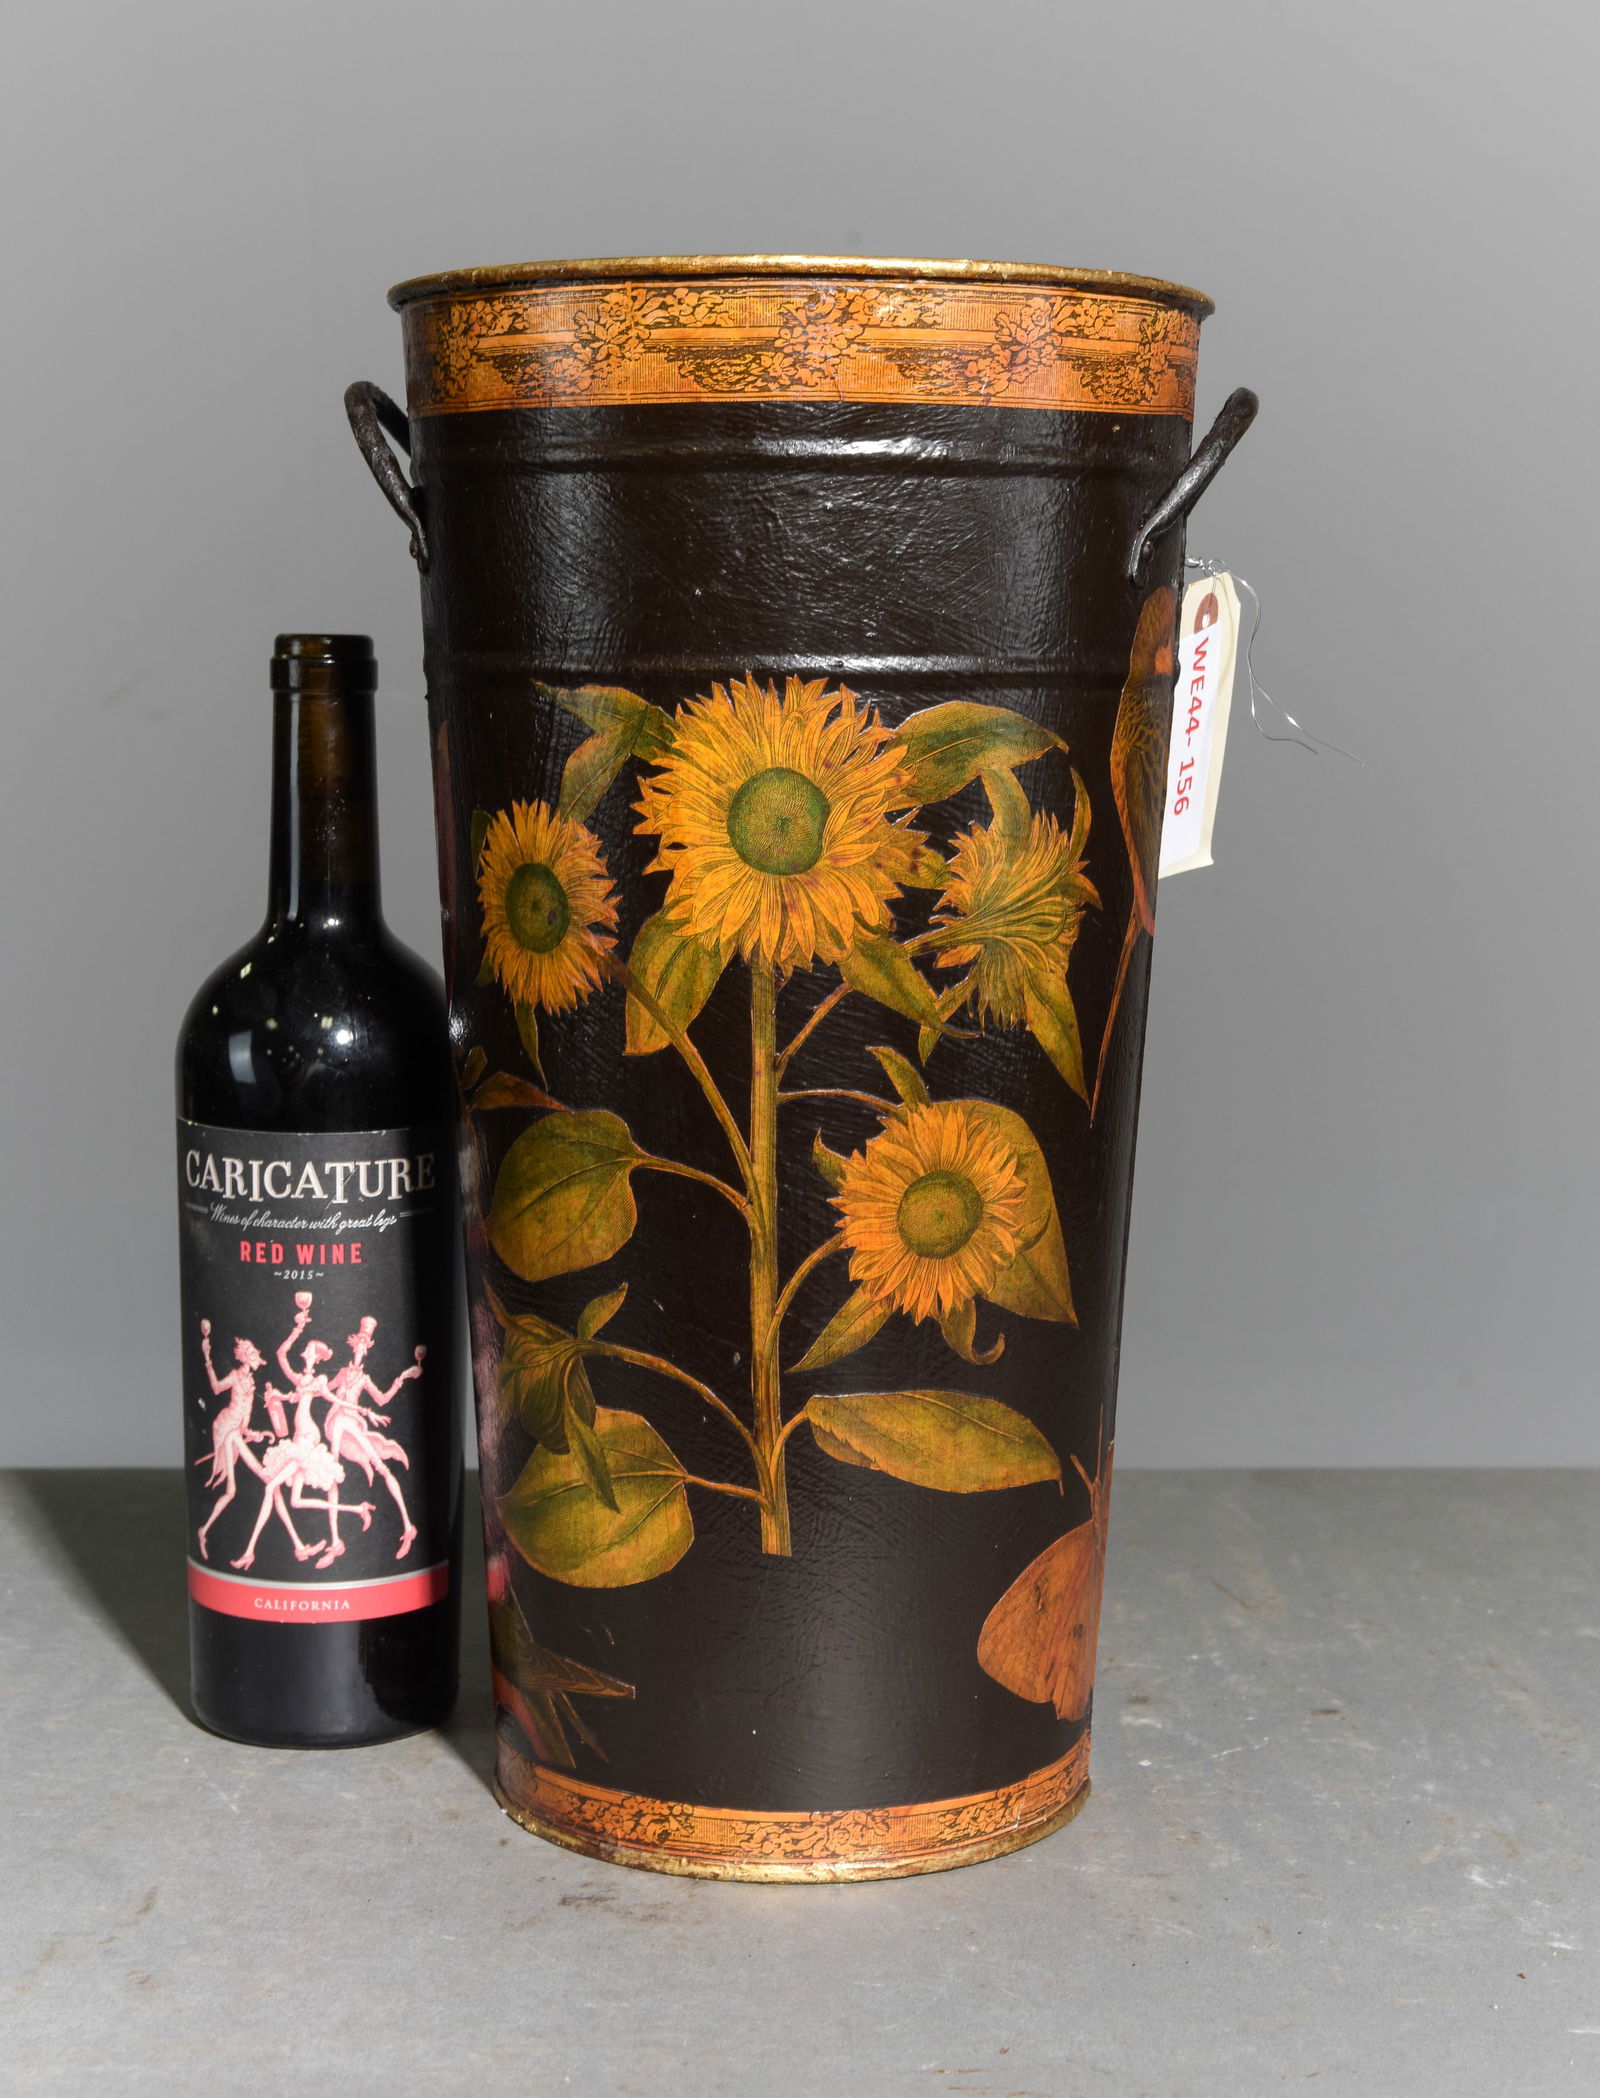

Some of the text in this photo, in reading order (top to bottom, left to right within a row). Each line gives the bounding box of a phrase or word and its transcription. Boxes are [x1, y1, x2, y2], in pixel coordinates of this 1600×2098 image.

[1173, 757, 1195, 816] 156
[185, 1149, 436, 1204] CARICATURE
[209, 1202, 398, 1236] Wines of character with great legs
[239, 1240, 363, 1265] RED WINE
[254, 1598, 351, 1612] CALIFORNIA
